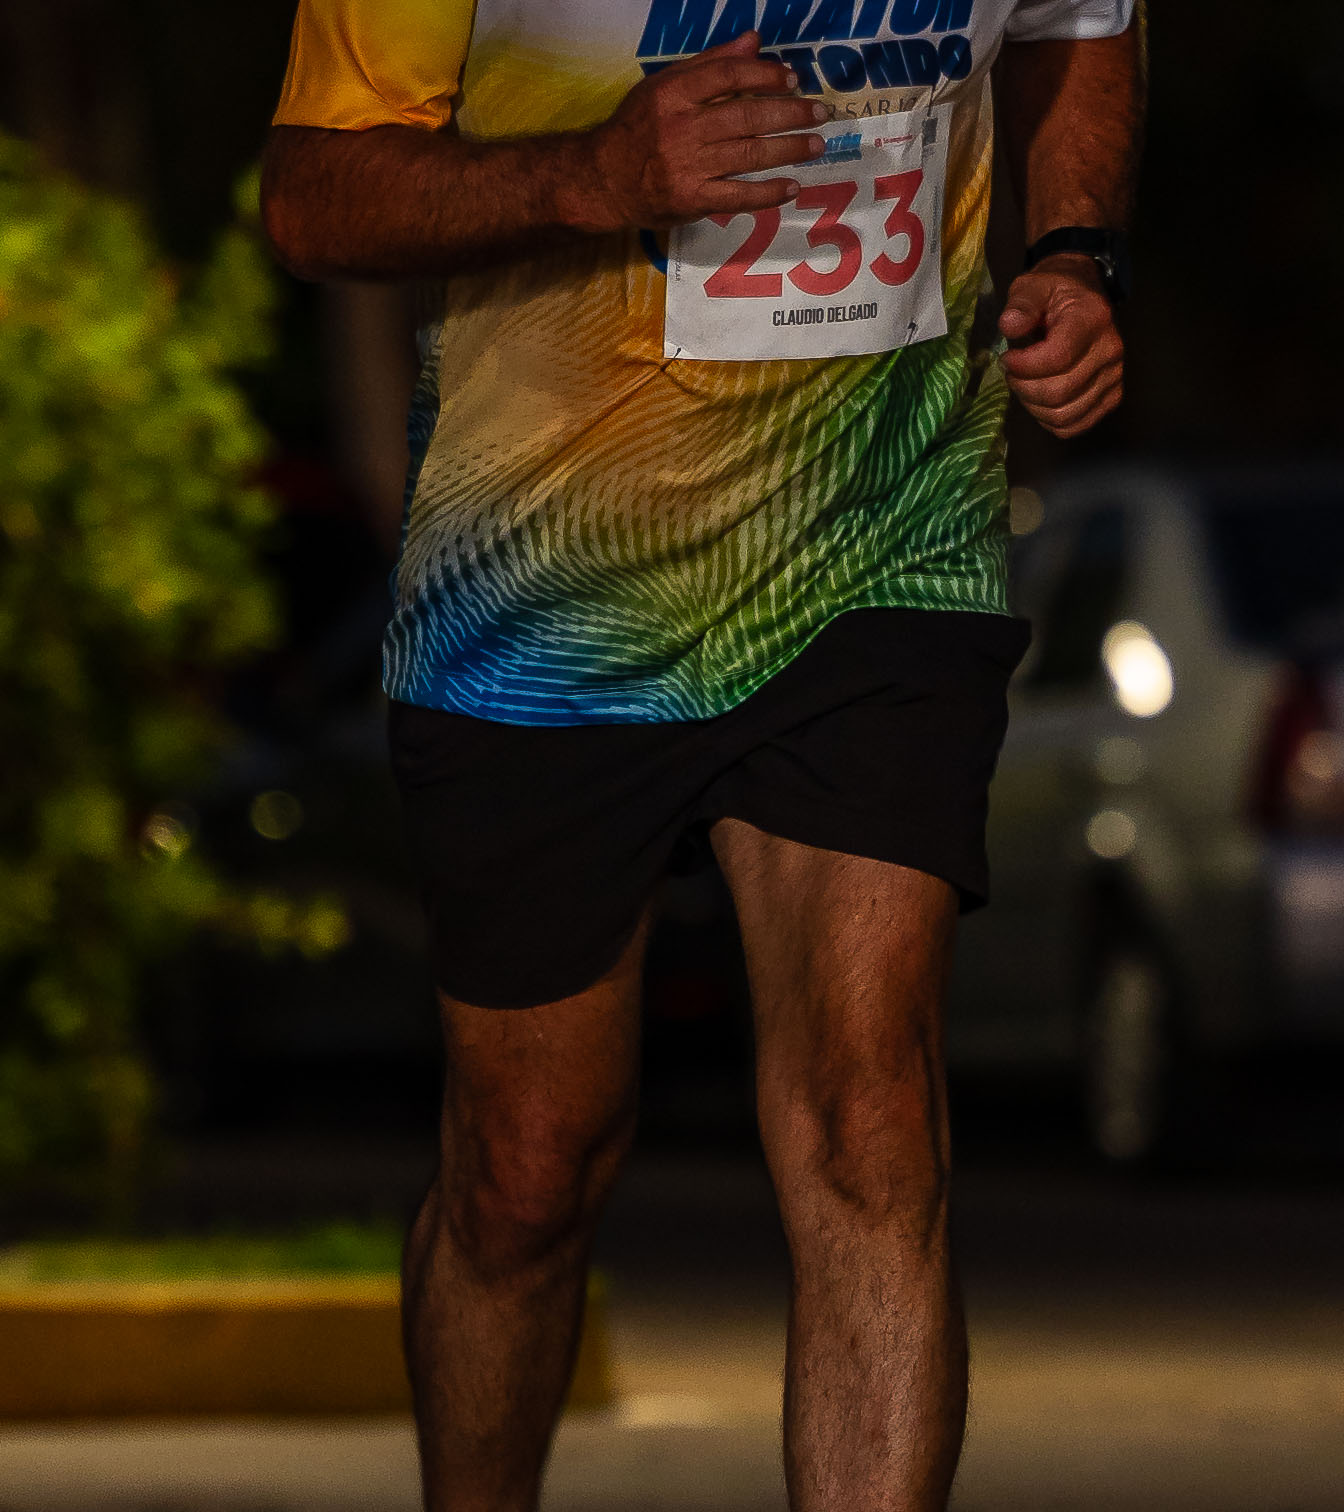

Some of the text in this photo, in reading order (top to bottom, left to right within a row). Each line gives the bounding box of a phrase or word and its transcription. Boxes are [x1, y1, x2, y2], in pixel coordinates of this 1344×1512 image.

[702, 168, 925, 298] 233
[772, 302, 878, 326] CLAUDIO DELGADO
